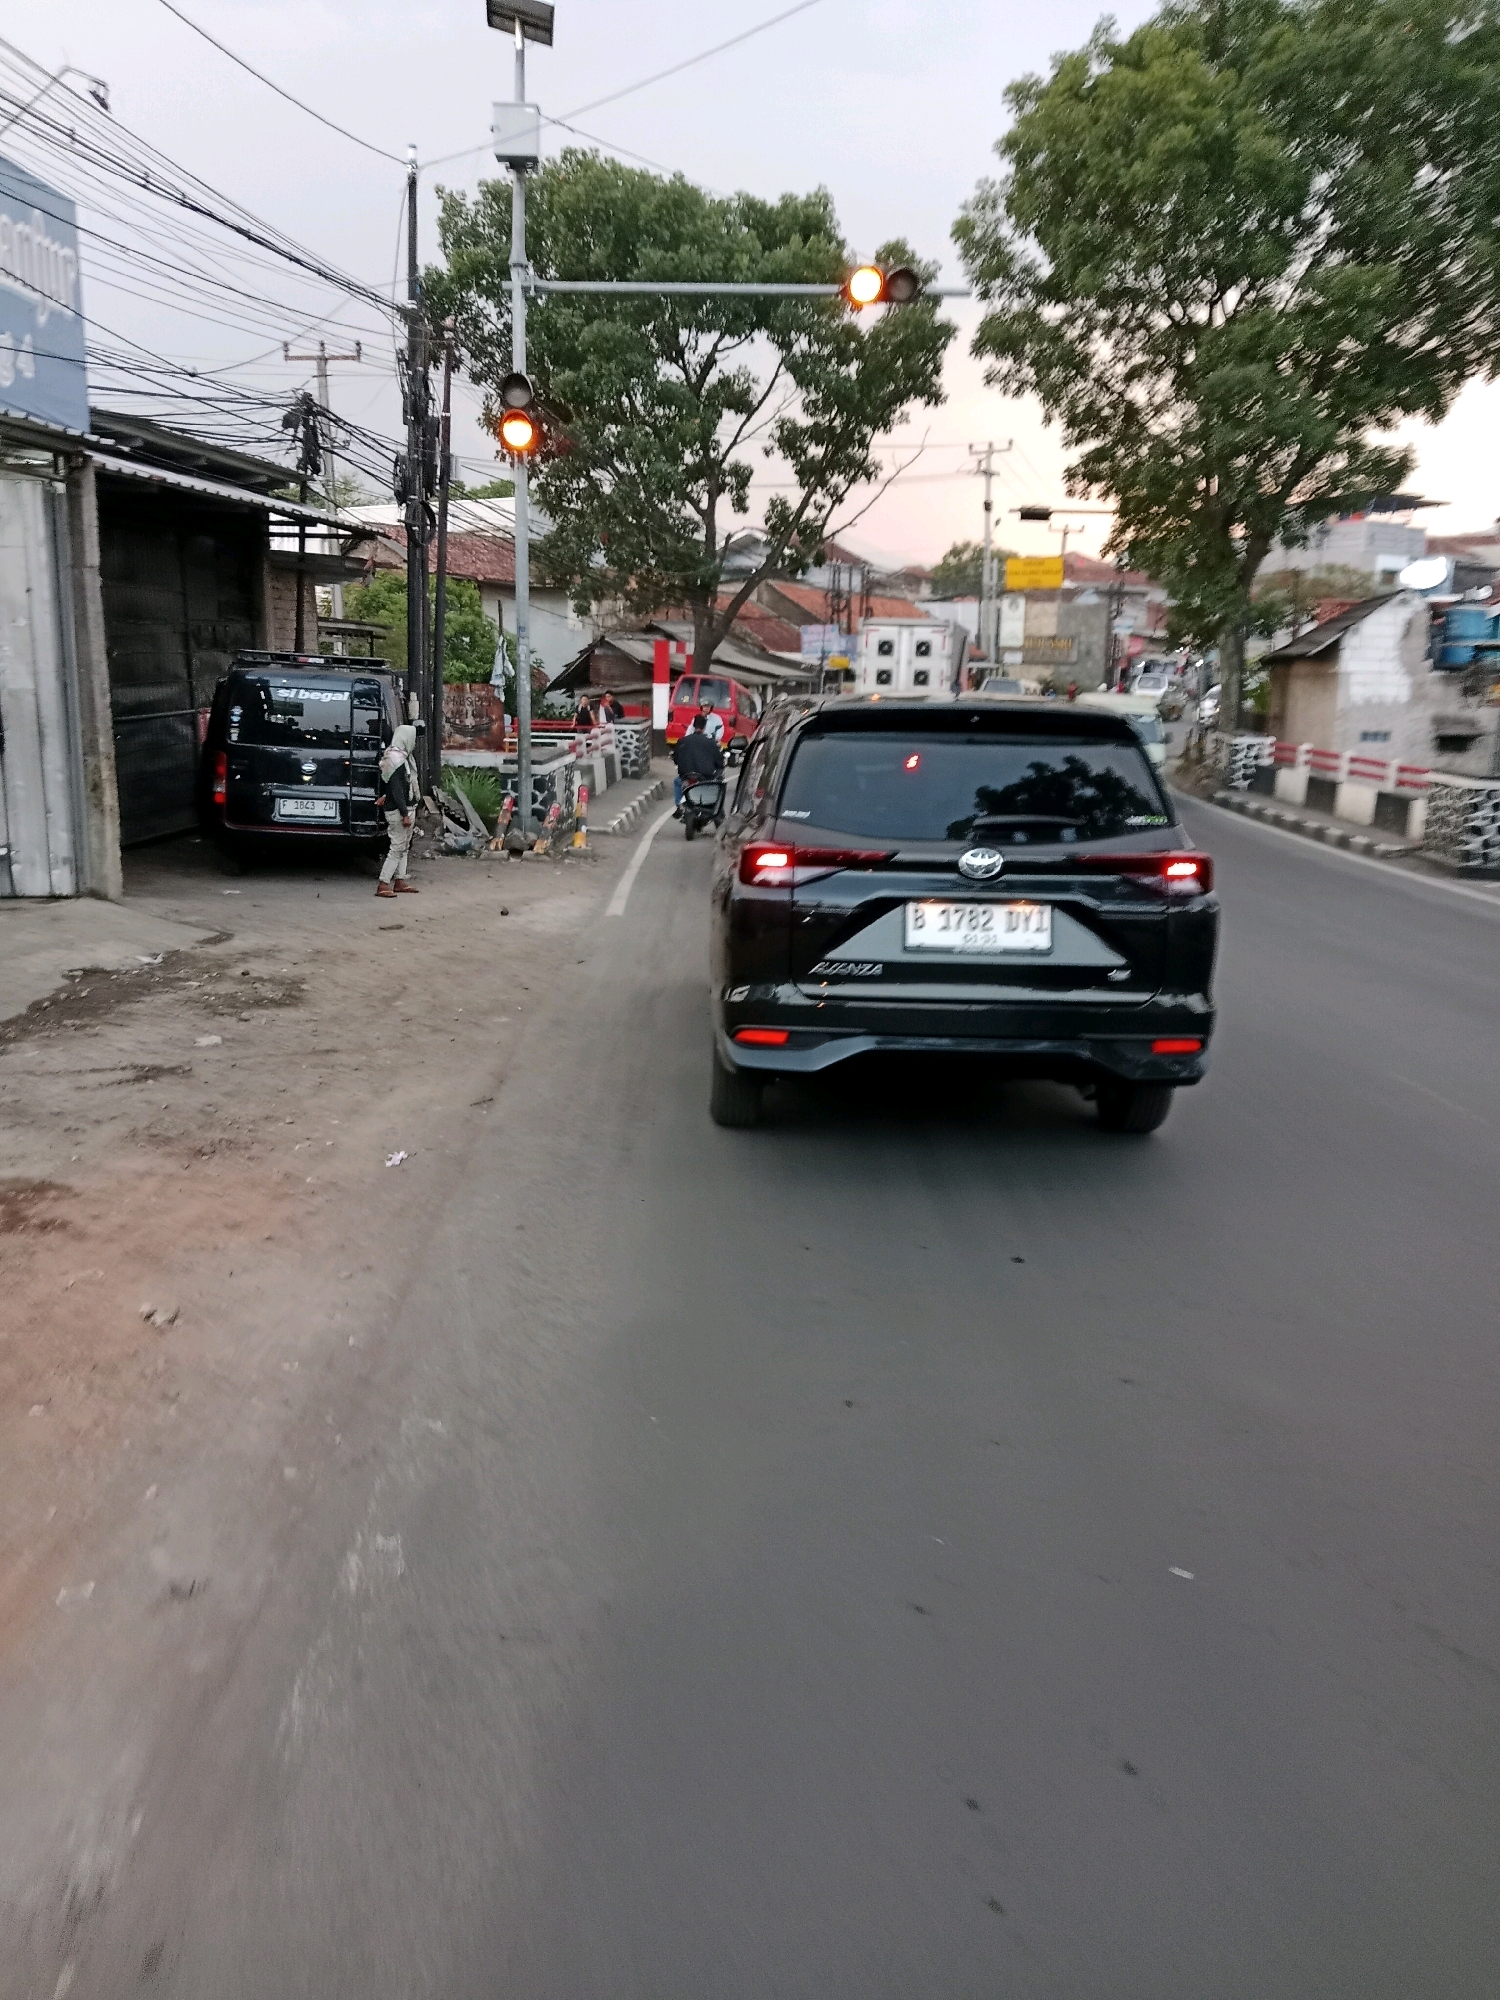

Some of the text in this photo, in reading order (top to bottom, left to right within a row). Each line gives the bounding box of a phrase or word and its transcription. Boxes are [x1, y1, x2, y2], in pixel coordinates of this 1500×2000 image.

[298, 689, 350, 702] begal
[282, 800, 288, 809] F
[912, 906, 926, 931] B
[938, 907, 994, 932] 1782
[807, 961, 884, 977] AVANZA
